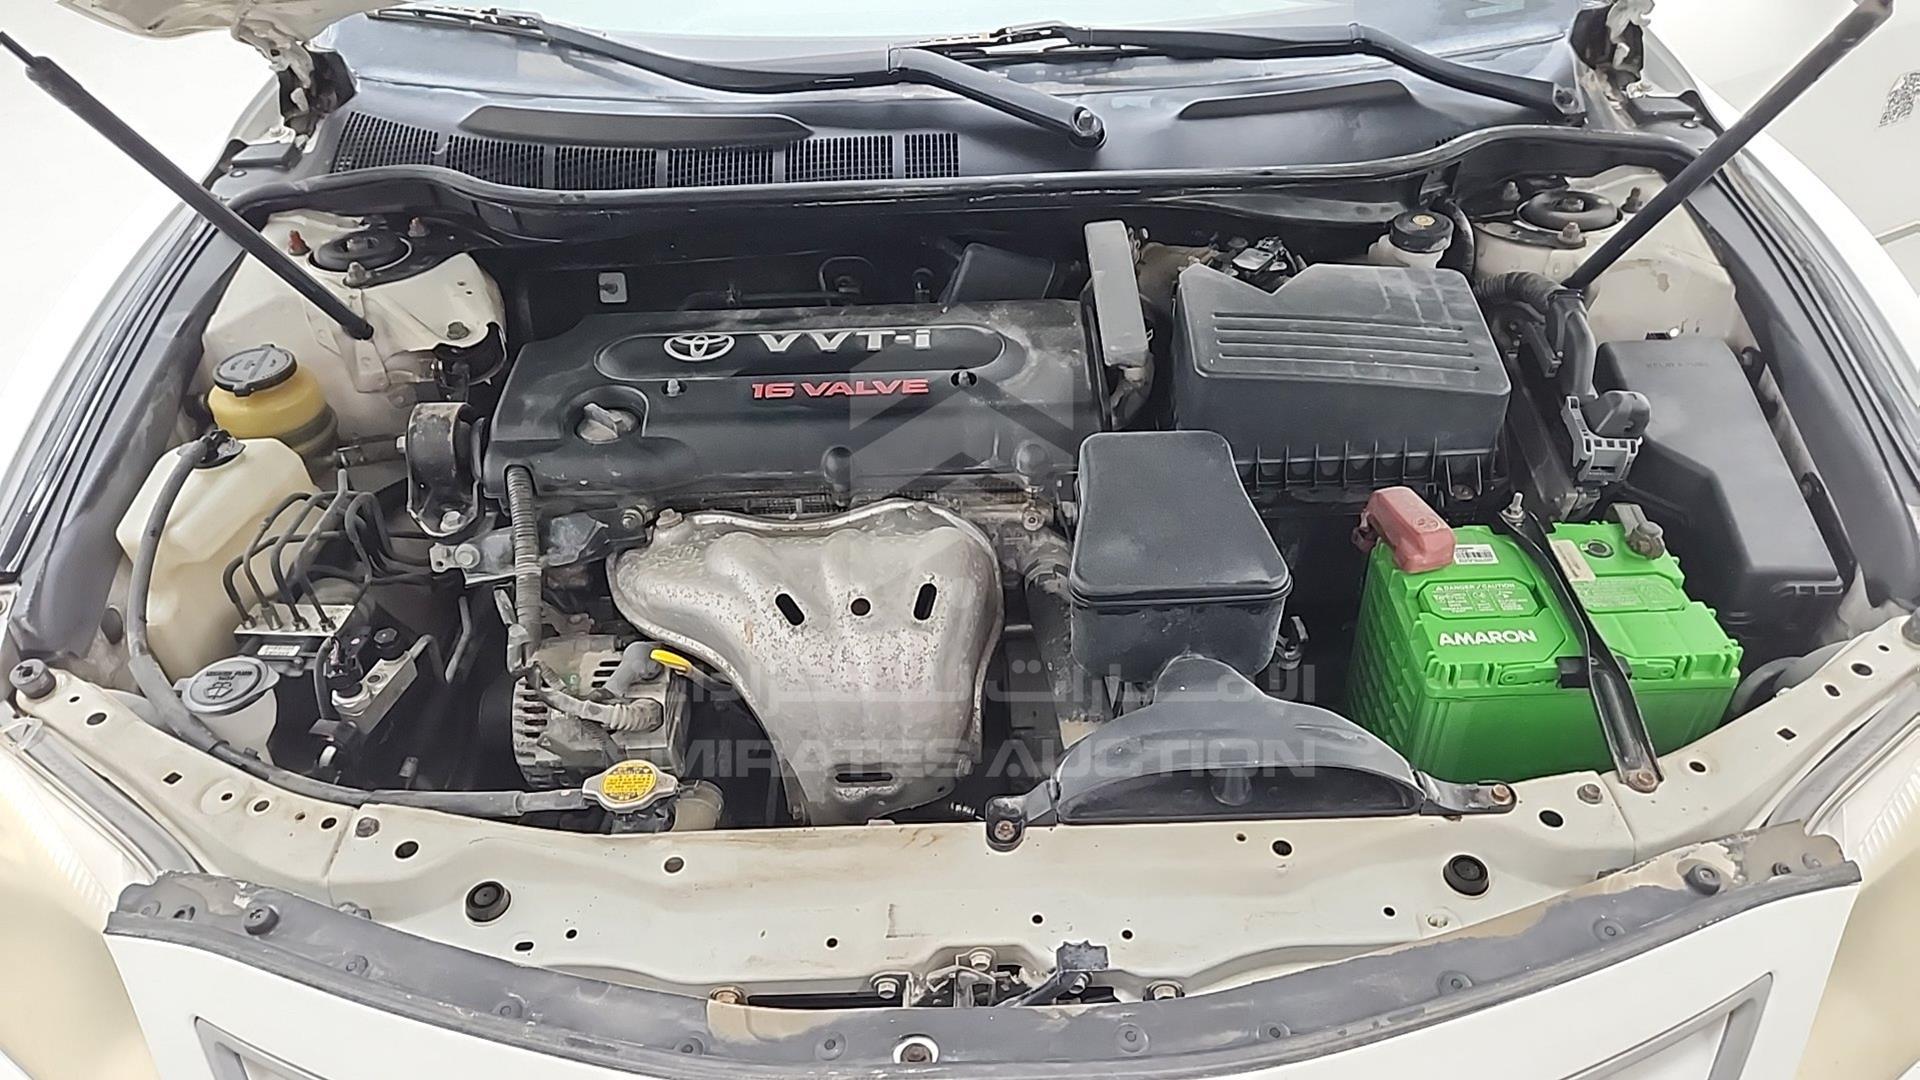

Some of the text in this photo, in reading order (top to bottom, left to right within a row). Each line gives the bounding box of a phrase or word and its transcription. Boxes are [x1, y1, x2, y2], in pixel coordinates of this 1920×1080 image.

[758, 328, 932, 353] VVT-i
[751, 378, 930, 400] 16 VALVE
[1439, 629, 1538, 646] AMARON
